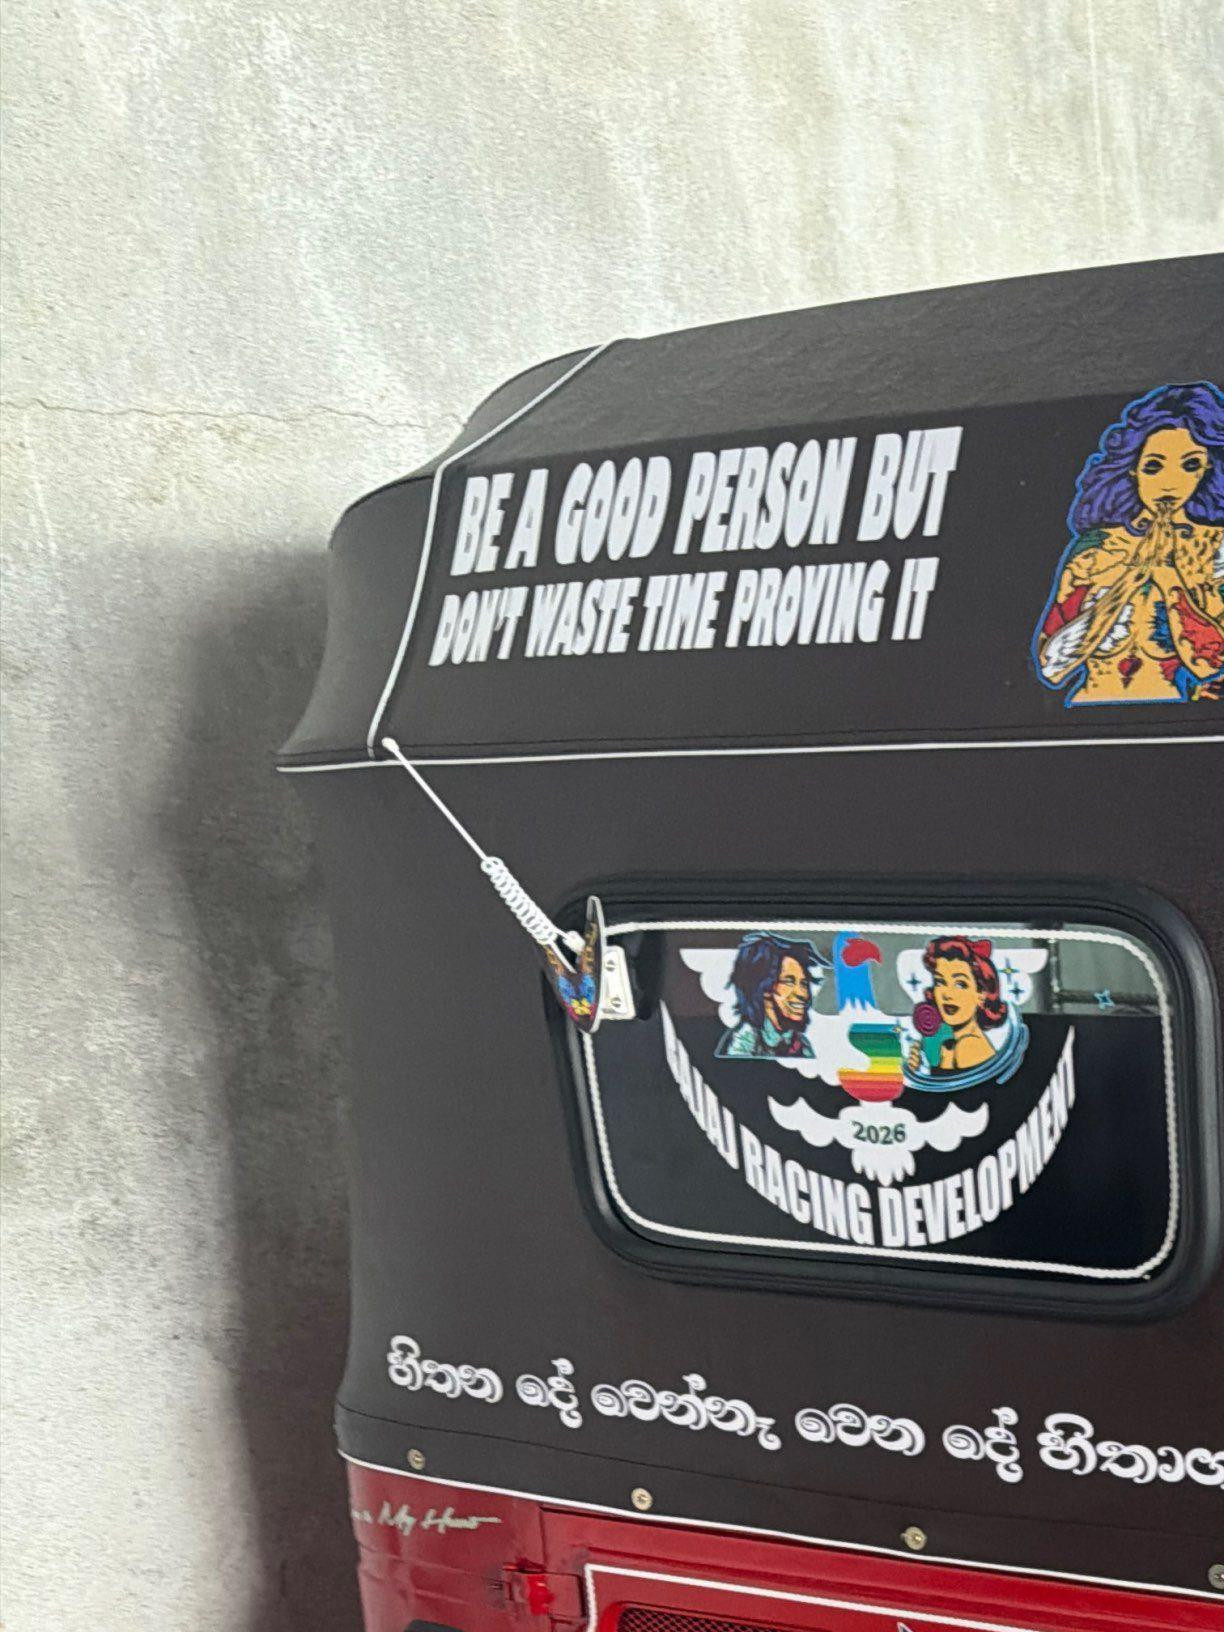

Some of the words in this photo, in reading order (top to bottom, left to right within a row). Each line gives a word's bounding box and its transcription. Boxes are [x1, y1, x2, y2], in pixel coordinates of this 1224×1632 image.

[450, 473, 514, 576] BE
[504, 468, 549, 569] A
[554, 455, 672, 565] GOOD
[672, 436, 858, 555] PERSON
[857, 426, 963, 542] BUT
[428, 586, 528, 667] DON'T
[525, 577, 641, 658] WASTE
[638, 571, 728, 651] TIME
[725, 560, 891, 648] PROVING
[892, 556, 940, 640] IT
[740, 1124, 875, 1248] RACING
[880, 1026, 1076, 1248] DEVELOPMENT
[850, 1120, 906, 1146] 2026
[387, 1335, 504, 1404] හිතන
[516, 1357, 583, 1429] දේ
[795, 1403, 926, 1456] වෙන
[942, 1406, 1024, 1484] දේ
